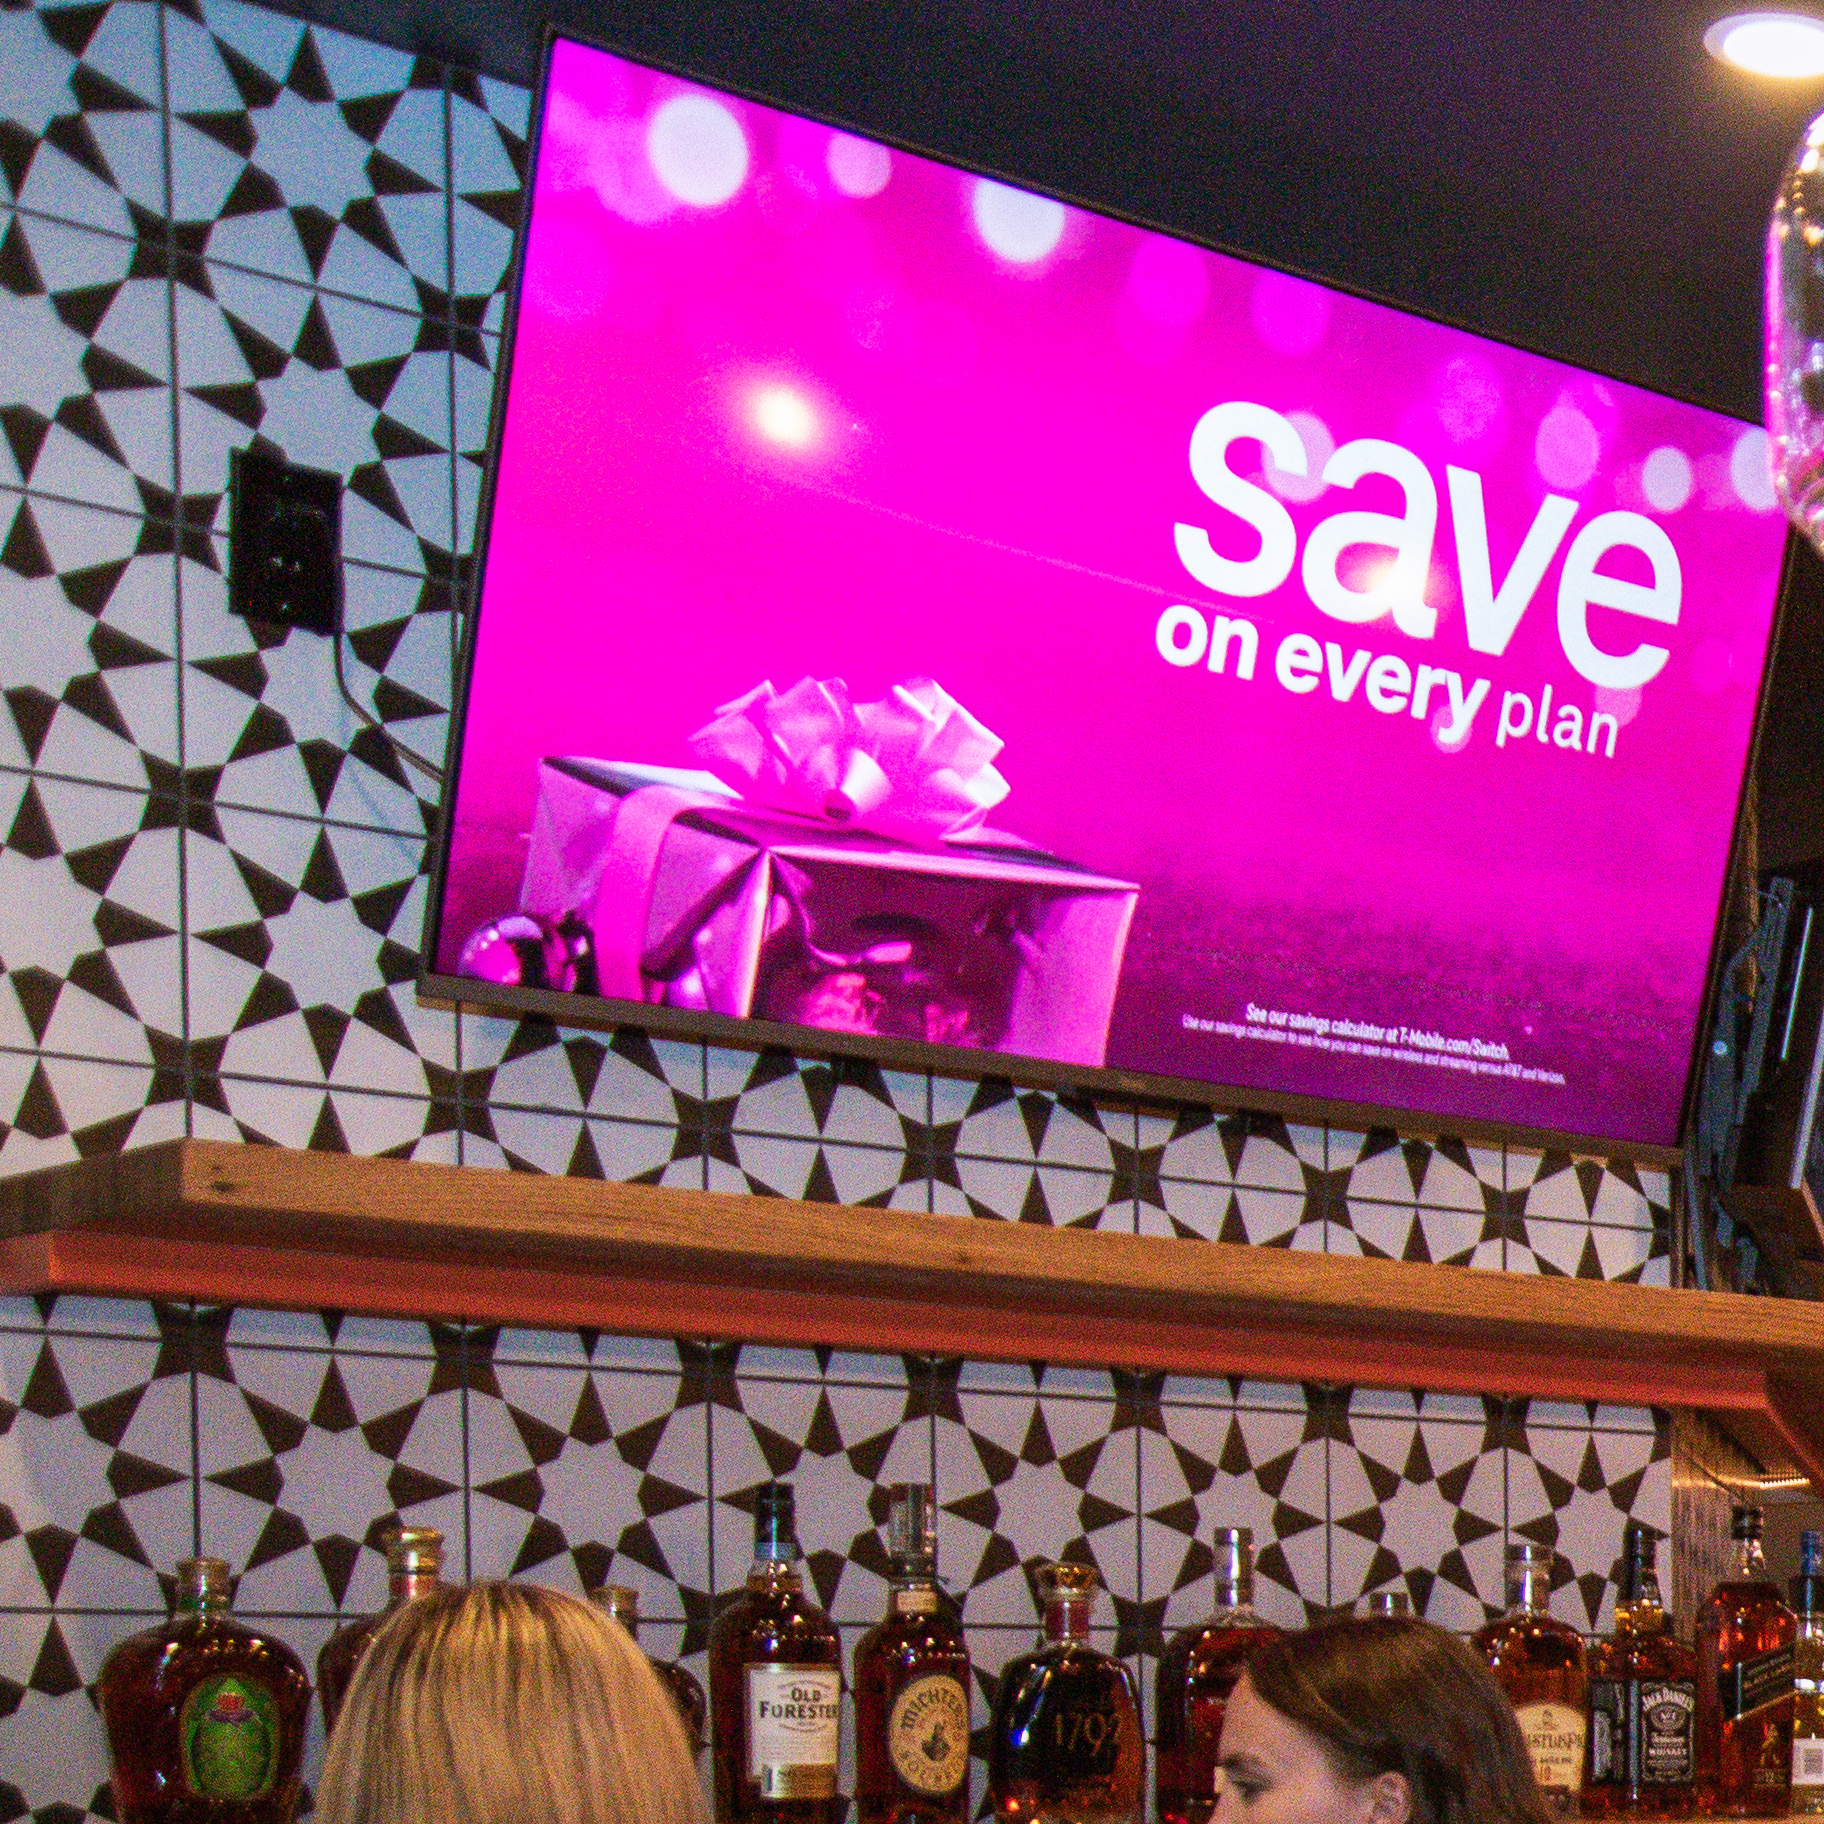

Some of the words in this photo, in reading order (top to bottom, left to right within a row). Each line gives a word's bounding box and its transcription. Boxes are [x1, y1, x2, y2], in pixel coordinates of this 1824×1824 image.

[1174, 401, 1682, 690] save
[1155, 604, 1259, 681] on
[1275, 632, 1491, 745] every
[1495, 684, 1619, 758] plan
[1246, 1002, 1268, 1023] See
[1268, 1010, 1288, 1026] our
[1288, 1012, 1330, 1036] savings
[1331, 1018, 1385, 1041] calculator
[1386, 1028, 1398, 1043] at
[791, 1687, 822, 1702] OLD
